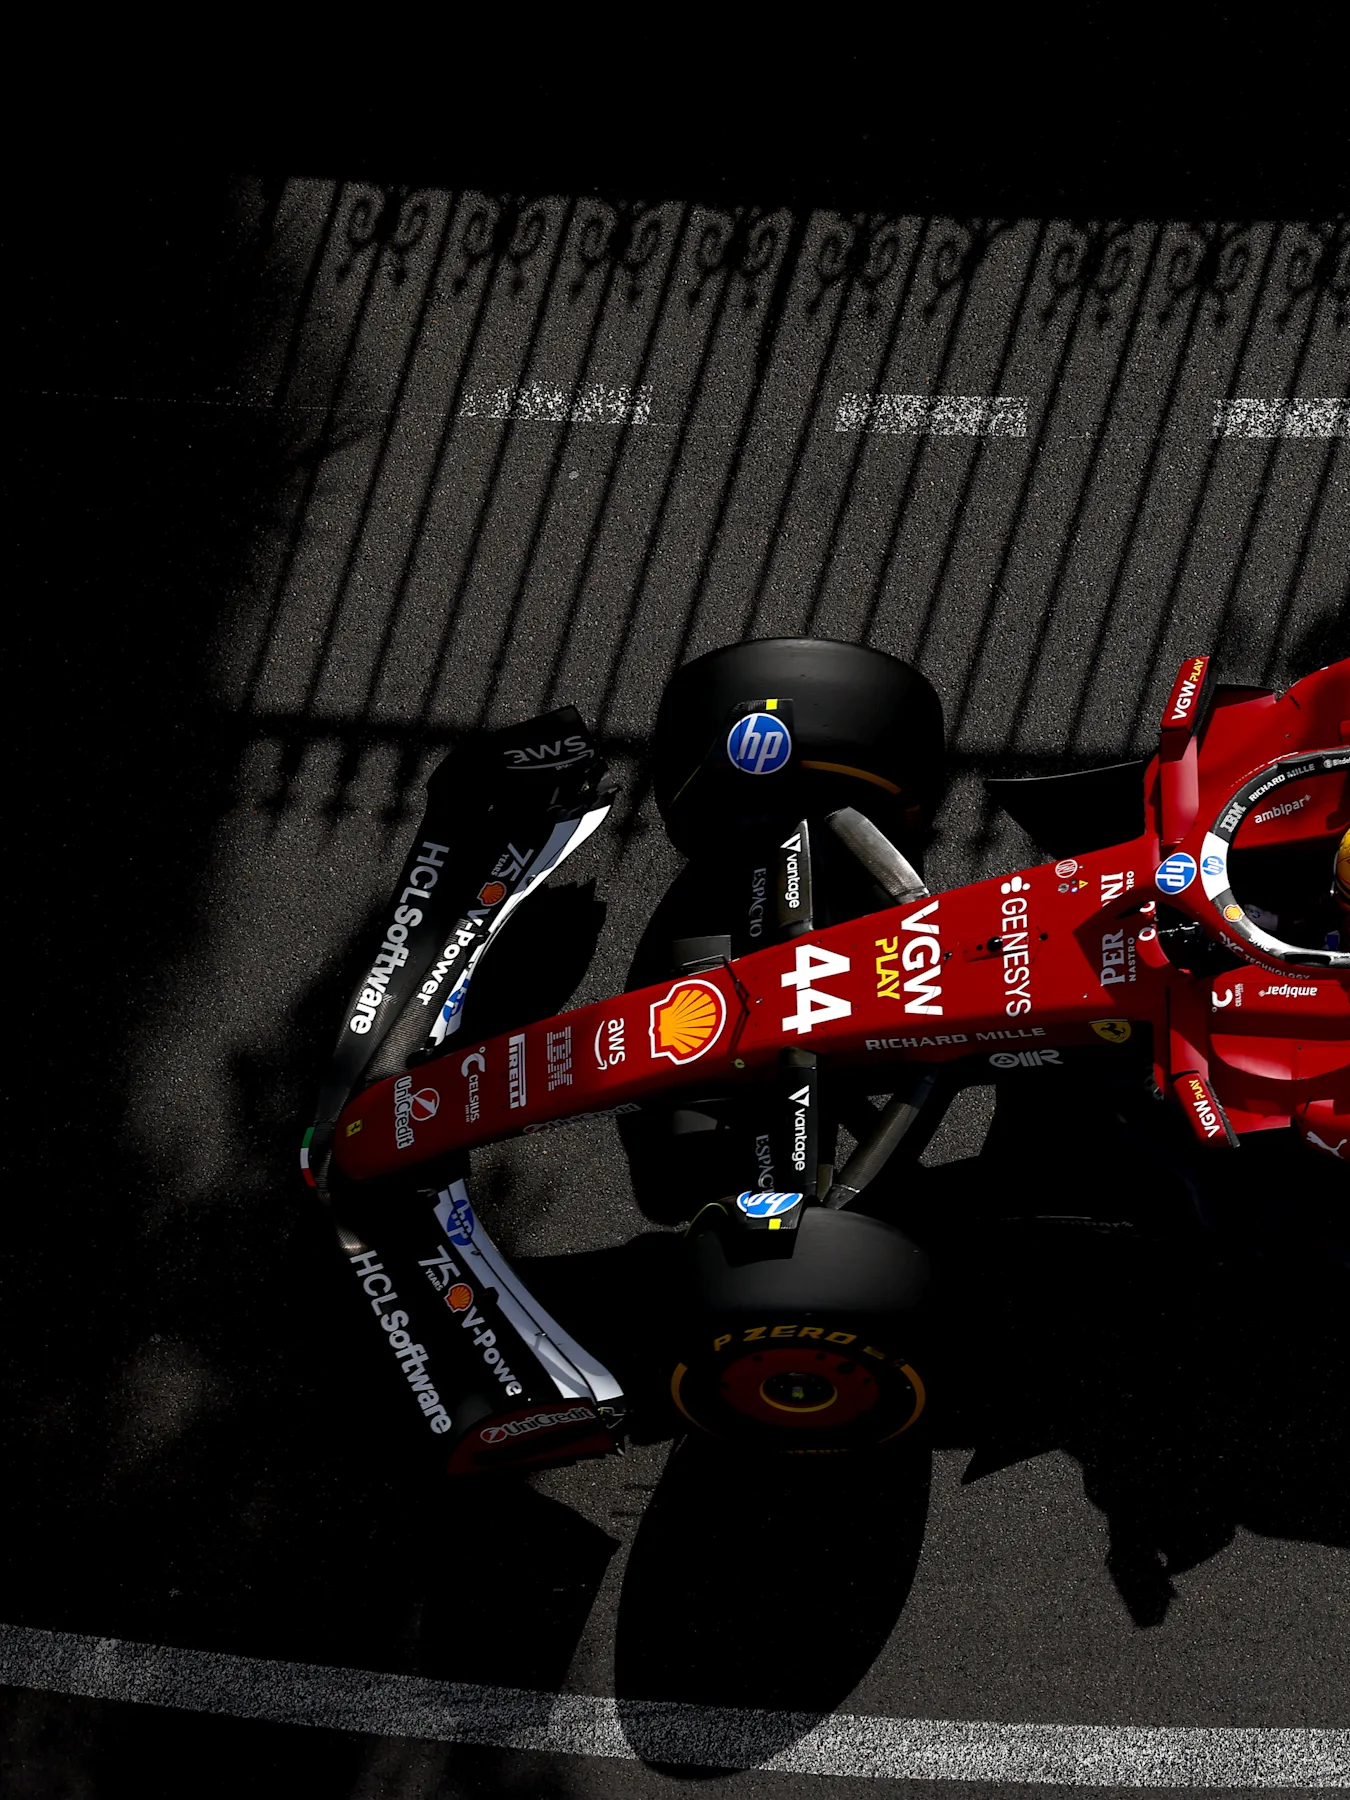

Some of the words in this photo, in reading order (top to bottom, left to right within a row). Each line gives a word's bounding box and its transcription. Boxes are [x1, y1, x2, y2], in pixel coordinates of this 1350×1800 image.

[1171, 680, 1196, 720] VGW
[1189, 659, 1204, 682] PLAY
[503, 735, 588, 765] aws
[734, 714, 785, 774] hp
[1219, 801, 1247, 833] IBM
[1248, 774, 1286, 802] RICHARD
[1286, 763, 1316, 779] MILLE
[1254, 797, 1306, 824] ambipar
[495, 842, 535, 881] 75
[785, 853, 801, 910] vantage
[1156, 855, 1197, 892] hp
[349, 840, 450, 1036] HCLSoftware
[417, 907, 491, 1007] V-Power
[901, 900, 943, 1016] VGW
[1001, 897, 1032, 1018] GENESYS
[1127, 937, 1137, 983] NASTRO
[1244, 953, 1311, 980] TECHNOLOGY
[781, 944, 852, 1035] 44
[875, 936, 900, 1001] PLAY
[1265, 984, 1318, 998] ambipar
[547, 1025, 573, 1092] IBM
[608, 1017, 626, 1066] aws
[865, 1034, 968, 1051] RICHARD
[975, 1027, 1046, 1042] MILLE
[468, 1073, 480, 1123] CELSIUS
[508, 1032, 526, 1109] PIRELLI
[394, 1075, 415, 1150] UniCredit
[792, 1109, 808, 1172] vantage
[1193, 1100, 1220, 1138] VGW
[417, 1244, 461, 1289] 75
[424, 1267, 444, 1292] YEARS
[350, 1250, 453, 1435] HCLSoftware
[461, 1305, 523, 1397] V-Powe
[713, 1333, 732, 1352] P
[742, 1325, 858, 1345] ZERO
[502, 1407, 597, 1437] UniCredit
